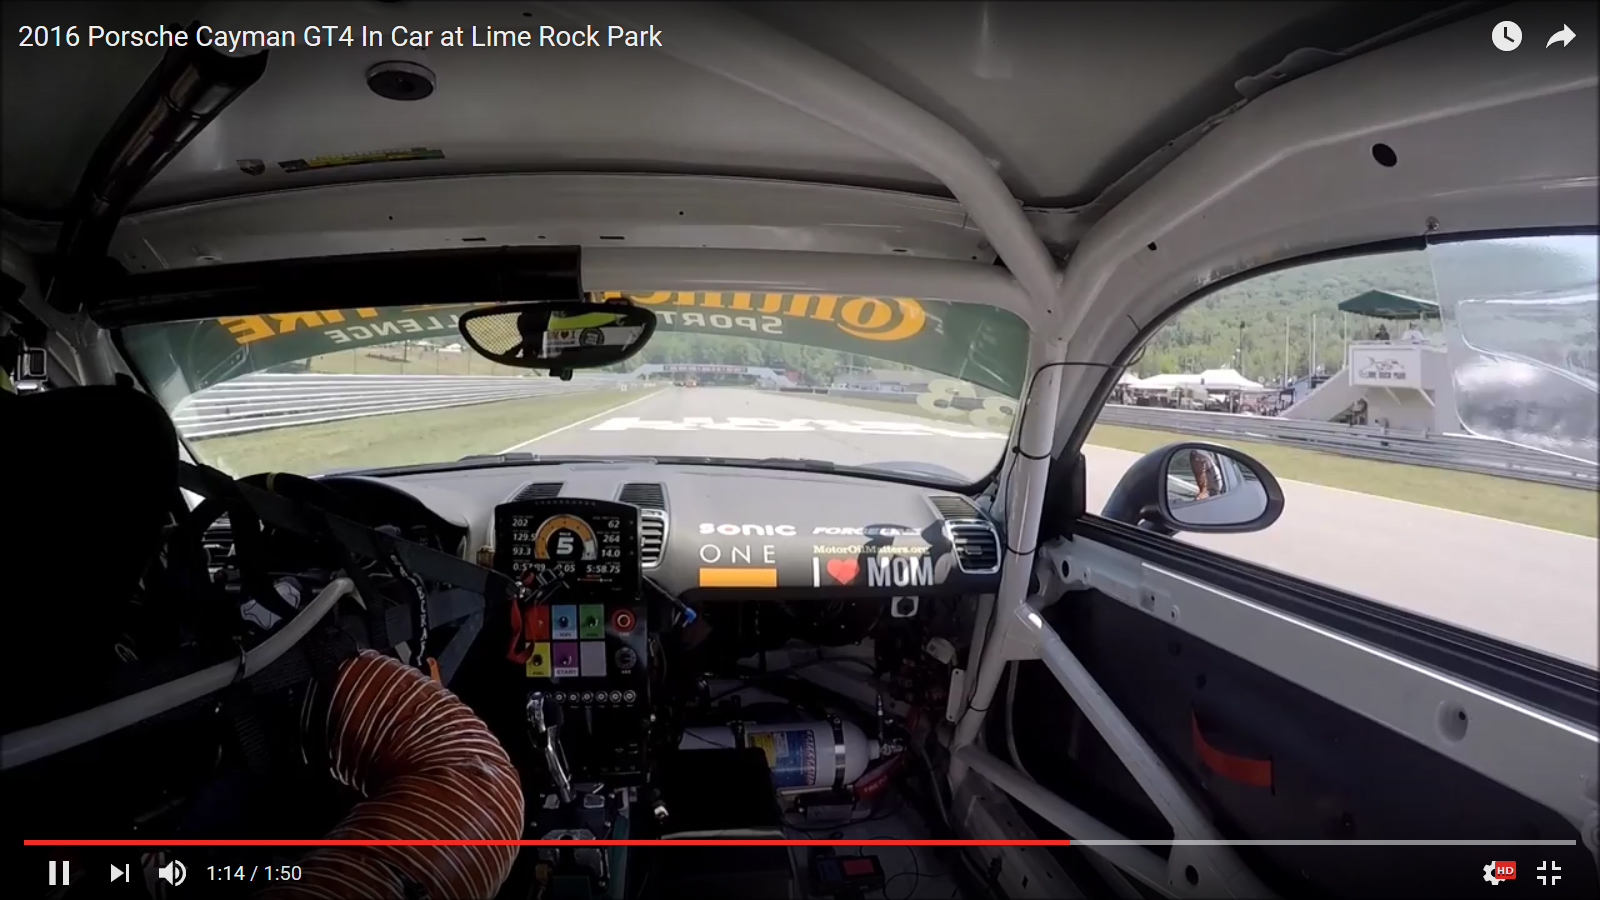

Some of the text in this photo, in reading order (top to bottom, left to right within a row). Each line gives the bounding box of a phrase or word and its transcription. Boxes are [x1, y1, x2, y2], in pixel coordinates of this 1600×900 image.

[512, 519, 528, 527] 202
[608, 520, 620, 528] 62
[513, 533, 536, 541] 129.5
[603, 535, 620, 543] 264
[556, 537, 574, 555] 5
[813, 544, 930, 556] MotorOilMatters.org
[513, 547, 531, 556] 93.3
[601, 549, 620, 557] 14.0
[699, 544, 776, 564] ONE
[586, 565, 620, 574] 5:58.75
[812, 556, 934, 588] I MOM
